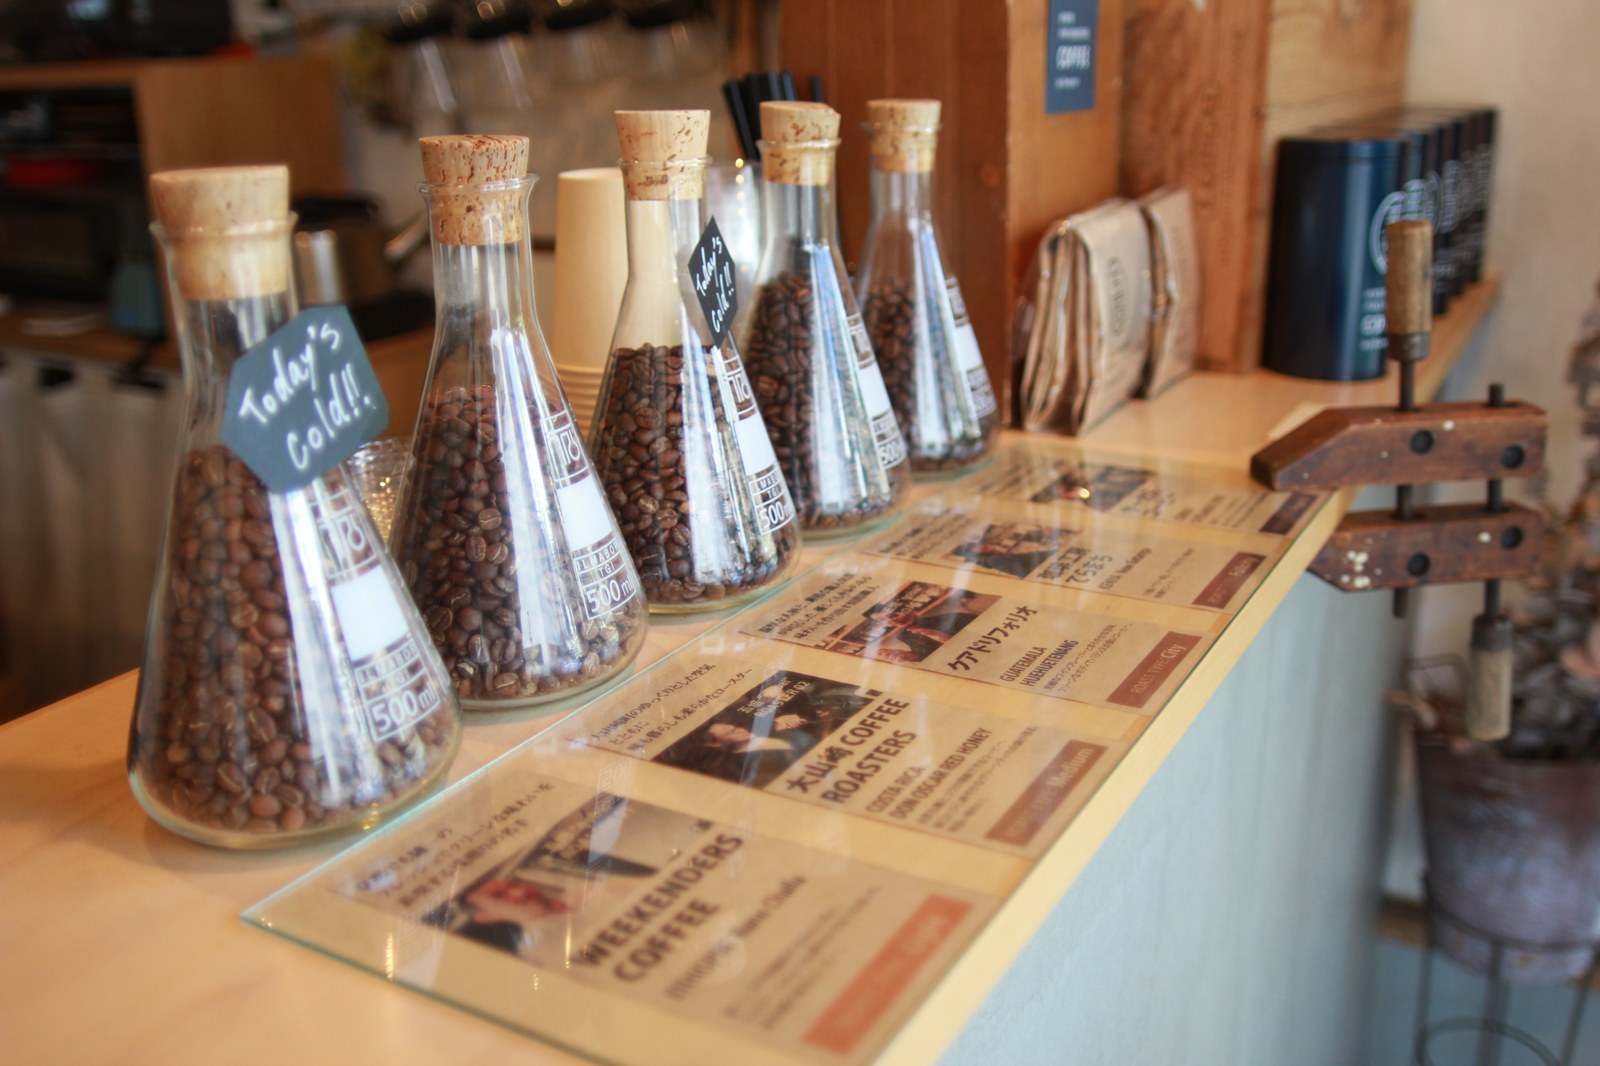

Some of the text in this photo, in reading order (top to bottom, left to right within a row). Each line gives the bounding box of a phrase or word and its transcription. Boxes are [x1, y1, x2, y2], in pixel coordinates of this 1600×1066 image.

[696, 236, 722, 296] Today's
[238, 322, 340, 424] Today's
[947, 605, 1038, 671] クアドリフォリオ
[1000, 645, 1047, 682] GUATEMALA
[1019, 639, 1079, 687] HUEHUETENANG
[1161, 643, 1187, 667] City
[840, 698, 910, 750] COFFEE
[821, 729, 917, 804] ROASTERS
[863, 765, 926, 814] COSTA RICA
[887, 797, 923, 819] DON
[908, 769, 950, 799] OSCAR
[937, 753, 967, 770] RED
[954, 727, 994, 755] HONEY
[1044, 746, 1096, 787] Medium
[573, 833, 743, 966] WEEKENDERS
[613, 899, 720, 982] COFFEE
